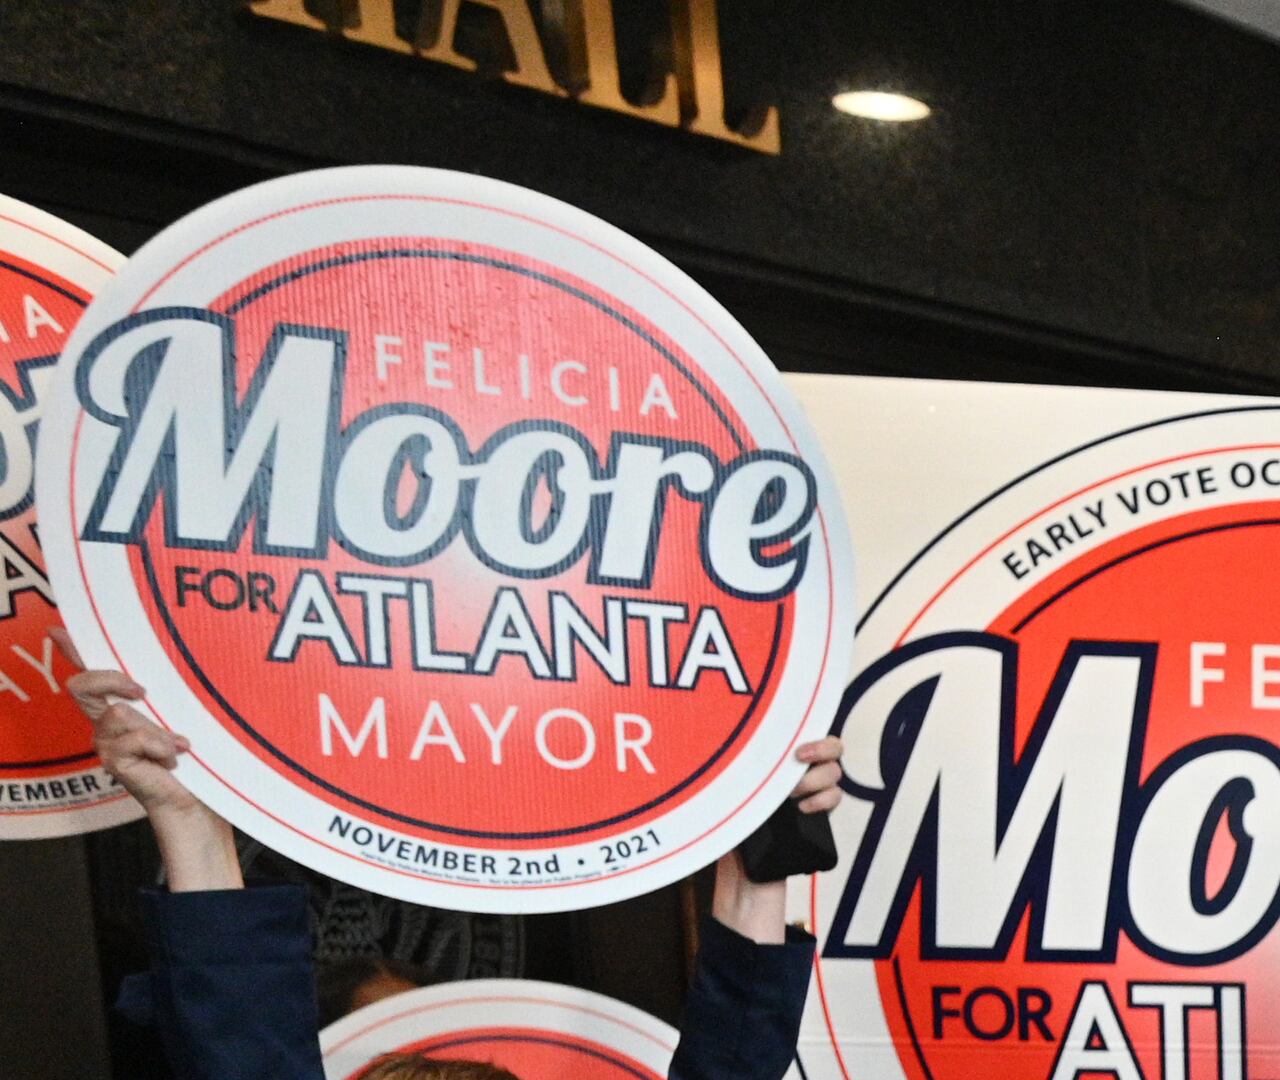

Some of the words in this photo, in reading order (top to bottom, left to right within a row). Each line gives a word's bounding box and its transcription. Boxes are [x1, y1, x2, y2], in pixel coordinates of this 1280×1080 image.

[250, 0, 780, 156] LL
[376, 336, 679, 419] FELICIA
[74, 307, 818, 598] Moore
[1002, 500, 1107, 581] EARLY
[1118, 466, 1216, 516] VOTE
[174, 565, 279, 613] FOR
[267, 572, 754, 695] ATLANTA
[320, 693, 656, 774] MAYOR
[0, 774, 101, 802] EMBER
[328, 815, 497, 875] NOVEMBER
[508, 854, 560, 875] 2nd
[600, 830, 661, 863] 2021
[932, 987, 1055, 1041] FOR
